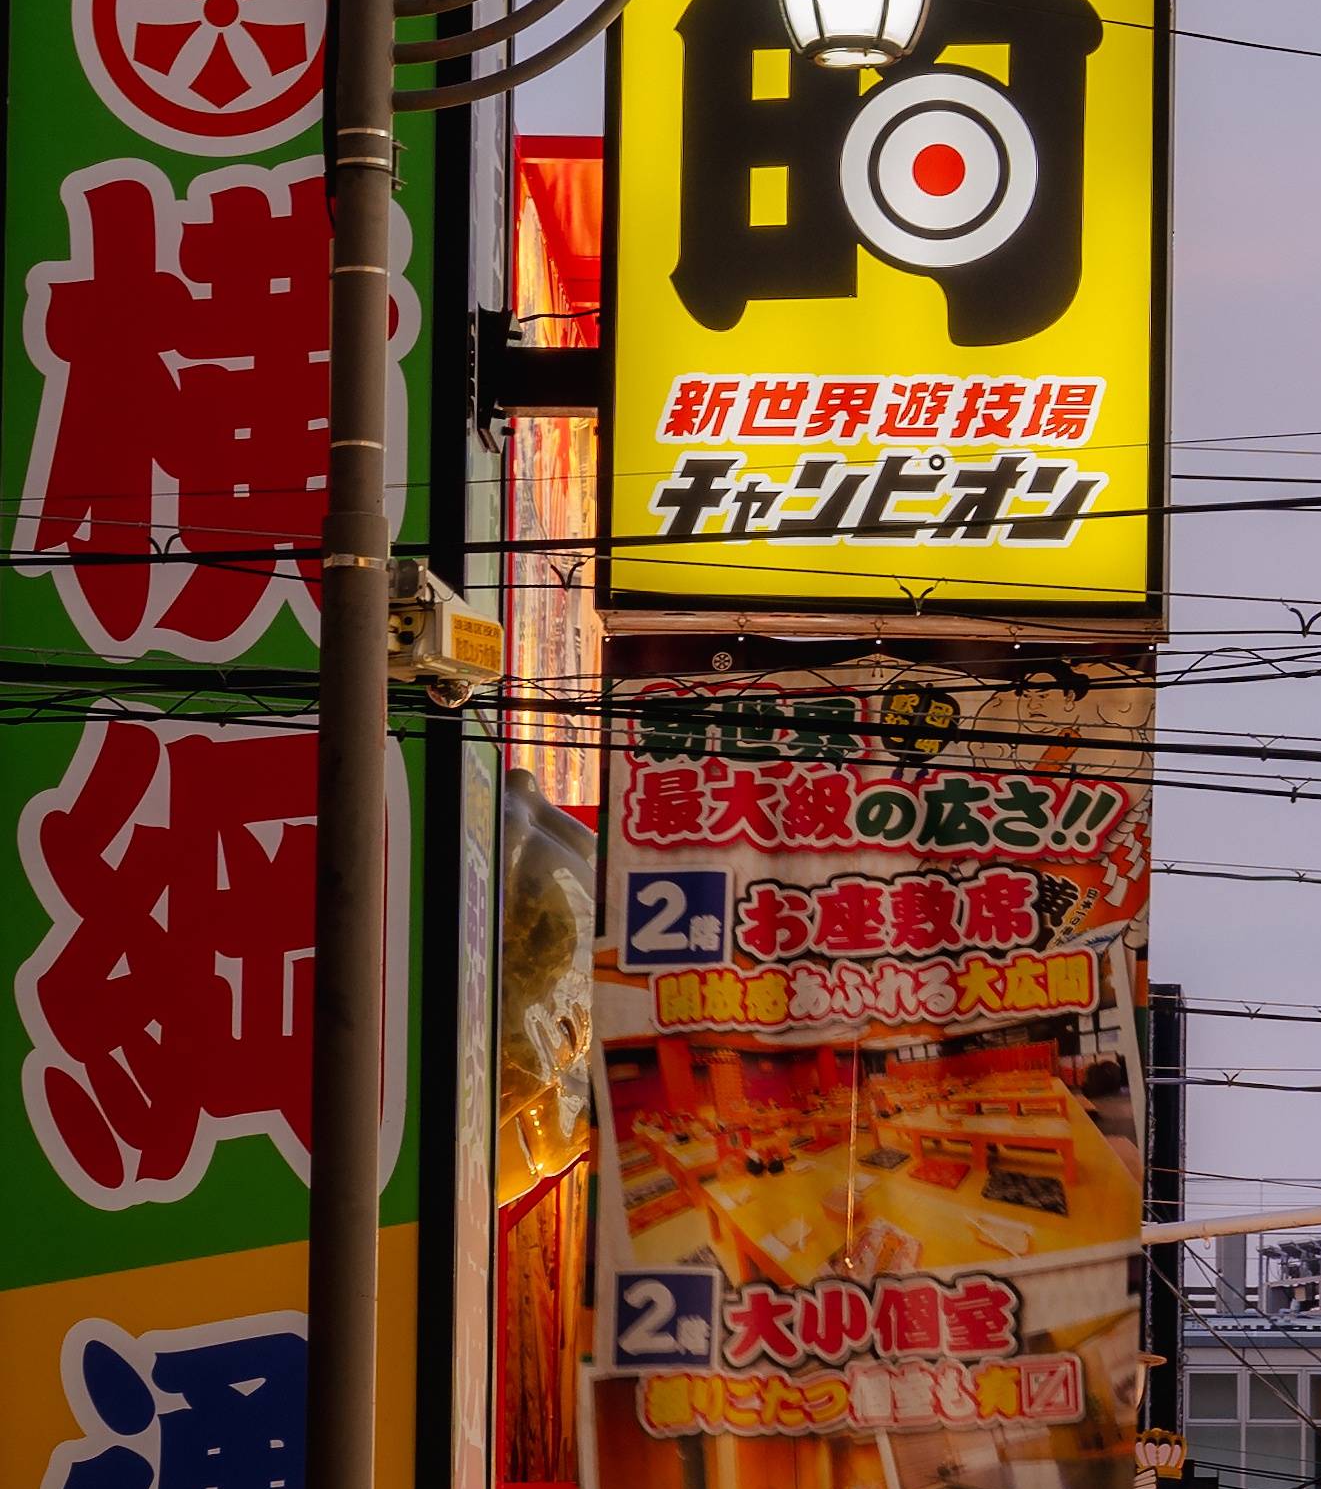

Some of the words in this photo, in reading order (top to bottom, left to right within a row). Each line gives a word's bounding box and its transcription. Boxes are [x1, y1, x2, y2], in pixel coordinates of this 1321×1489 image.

[664, 376, 1100, 443] 新世界遊技場
[654, 452, 1102, 546] チャンピオン
[639, 765, 1117, 849] 最大級の広さ!!
[742, 873, 1040, 956] お座敷席
[657, 953, 1092, 1025] 開放感あふれる大広間
